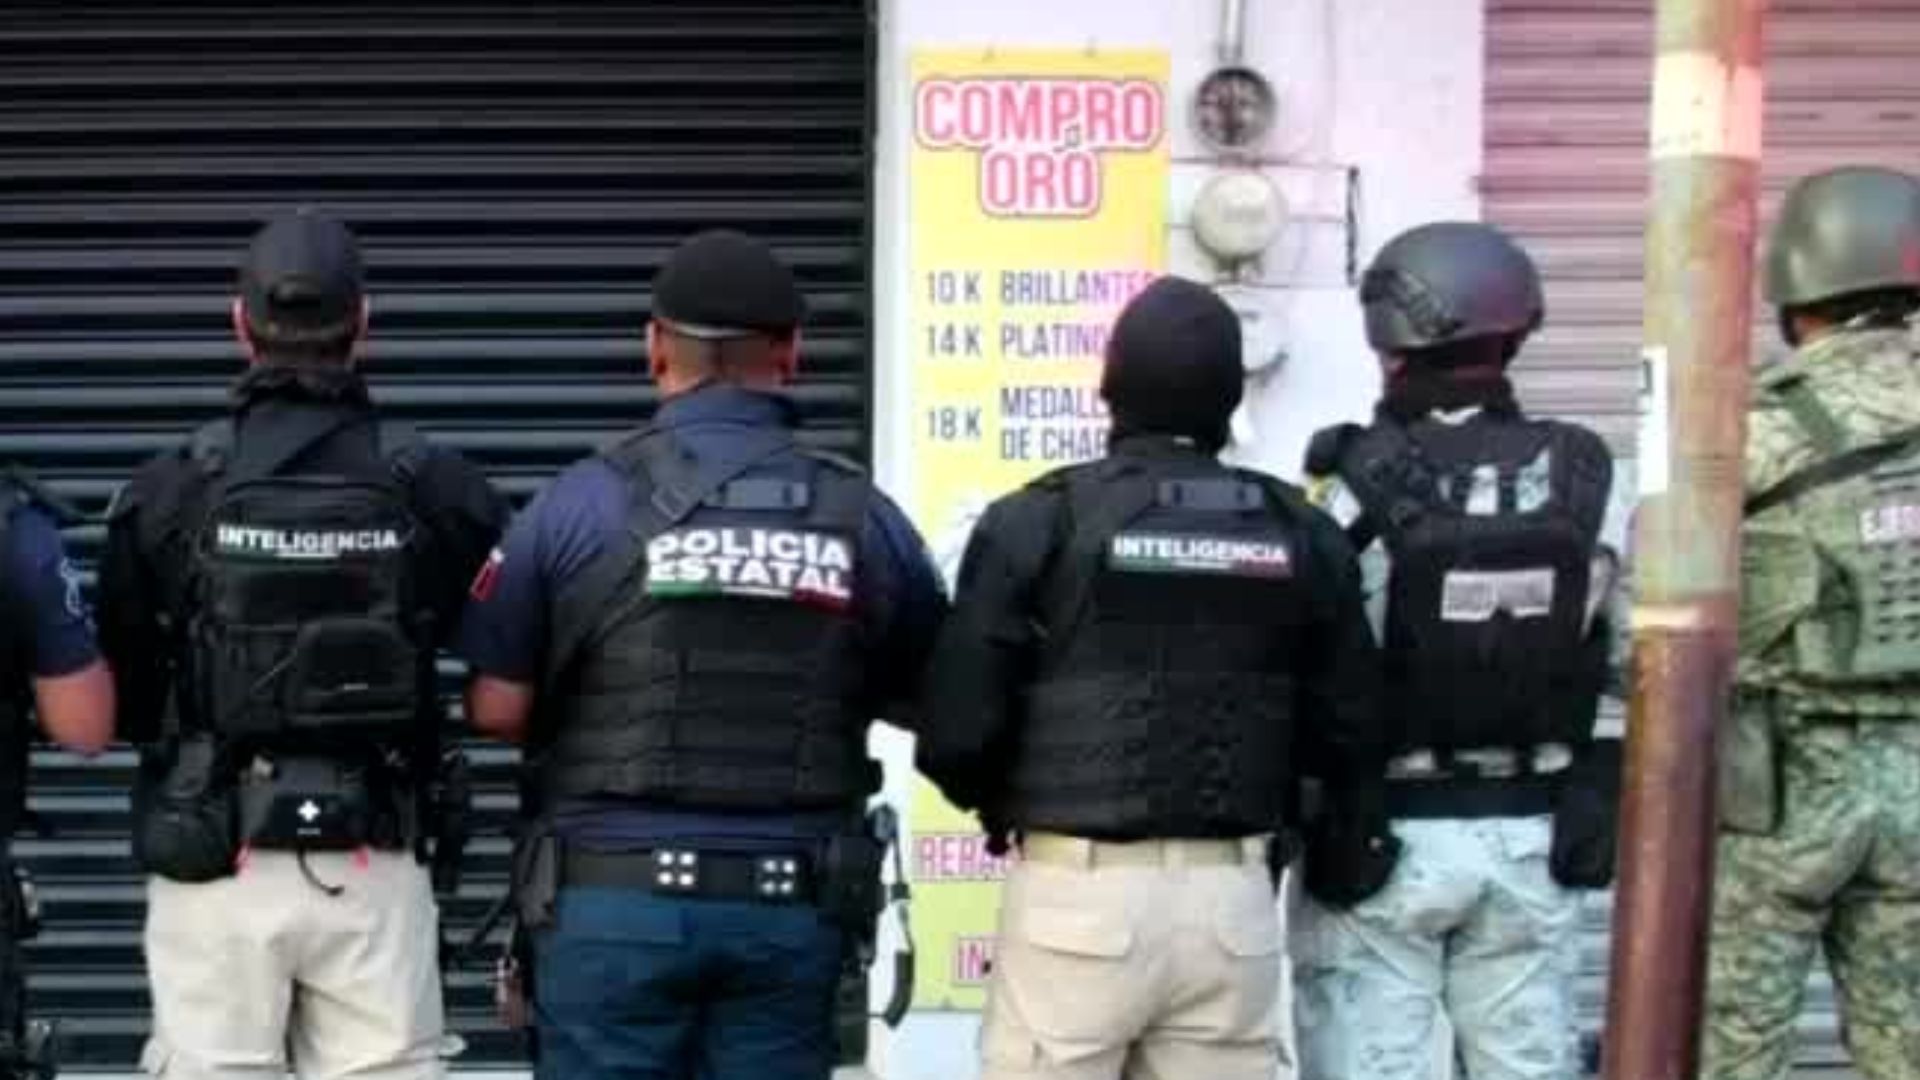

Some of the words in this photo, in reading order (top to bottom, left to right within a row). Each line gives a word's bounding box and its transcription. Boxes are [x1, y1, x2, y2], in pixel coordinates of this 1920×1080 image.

[922, 83, 1158, 142] COMPRO
[985, 152, 1095, 208] ORO
[927, 271, 957, 305] 10
[964, 271, 982, 304] K
[927, 324, 957, 357] 14
[964, 325, 982, 356] K
[1001, 386, 1107, 419] MEDALL
[928, 407, 957, 439] 18
[965, 407, 982, 438] K
[1001, 427, 1031, 461] DE
[217, 523, 398, 551] INTELIGENCIA
[647, 528, 851, 569] POLICIA
[1114, 535, 1288, 563] INTELIGENCIA
[650, 556, 852, 598] ESTATAL
